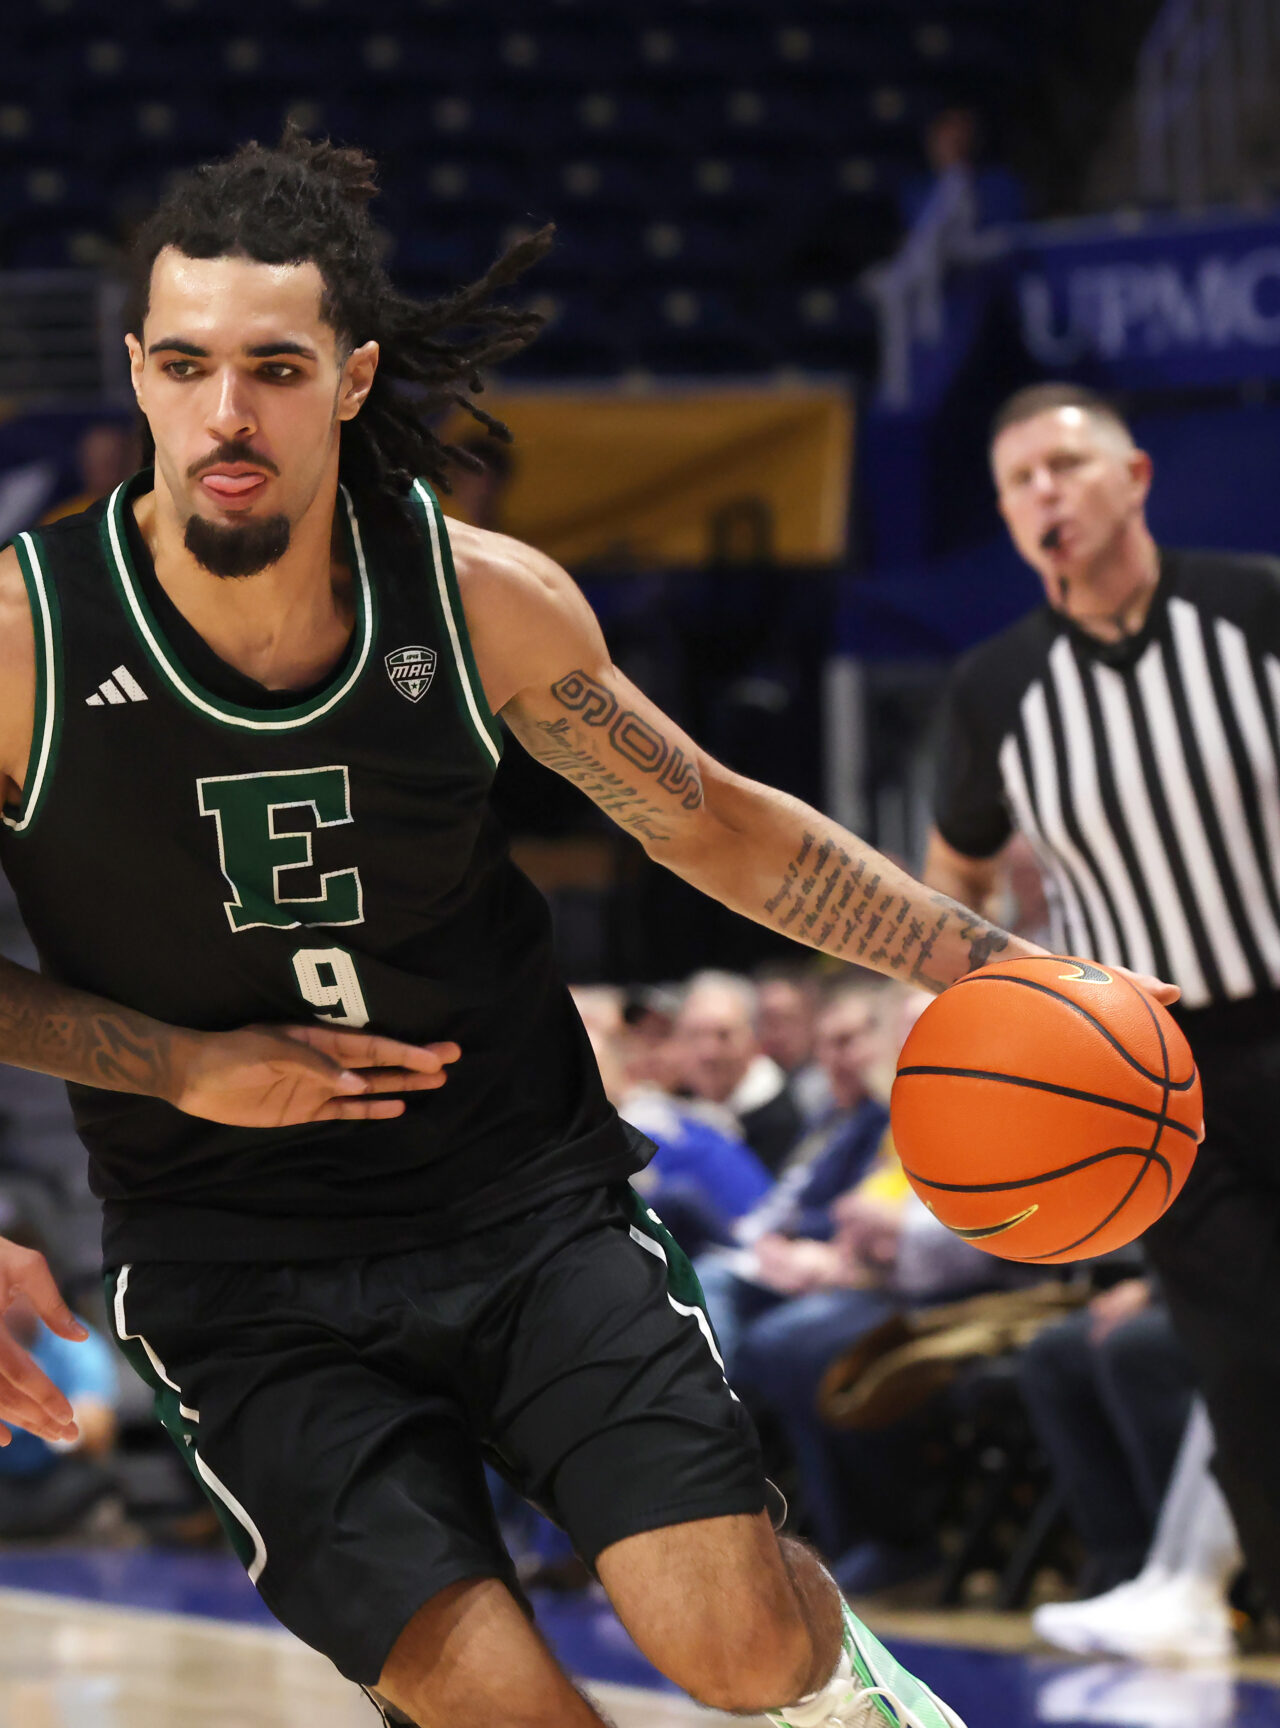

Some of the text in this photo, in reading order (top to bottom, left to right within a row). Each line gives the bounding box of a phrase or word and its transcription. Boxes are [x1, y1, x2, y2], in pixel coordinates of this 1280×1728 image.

[390, 663, 434, 680] MAC
[196, 764, 366, 934] E
[291, 946, 370, 1029] 9
